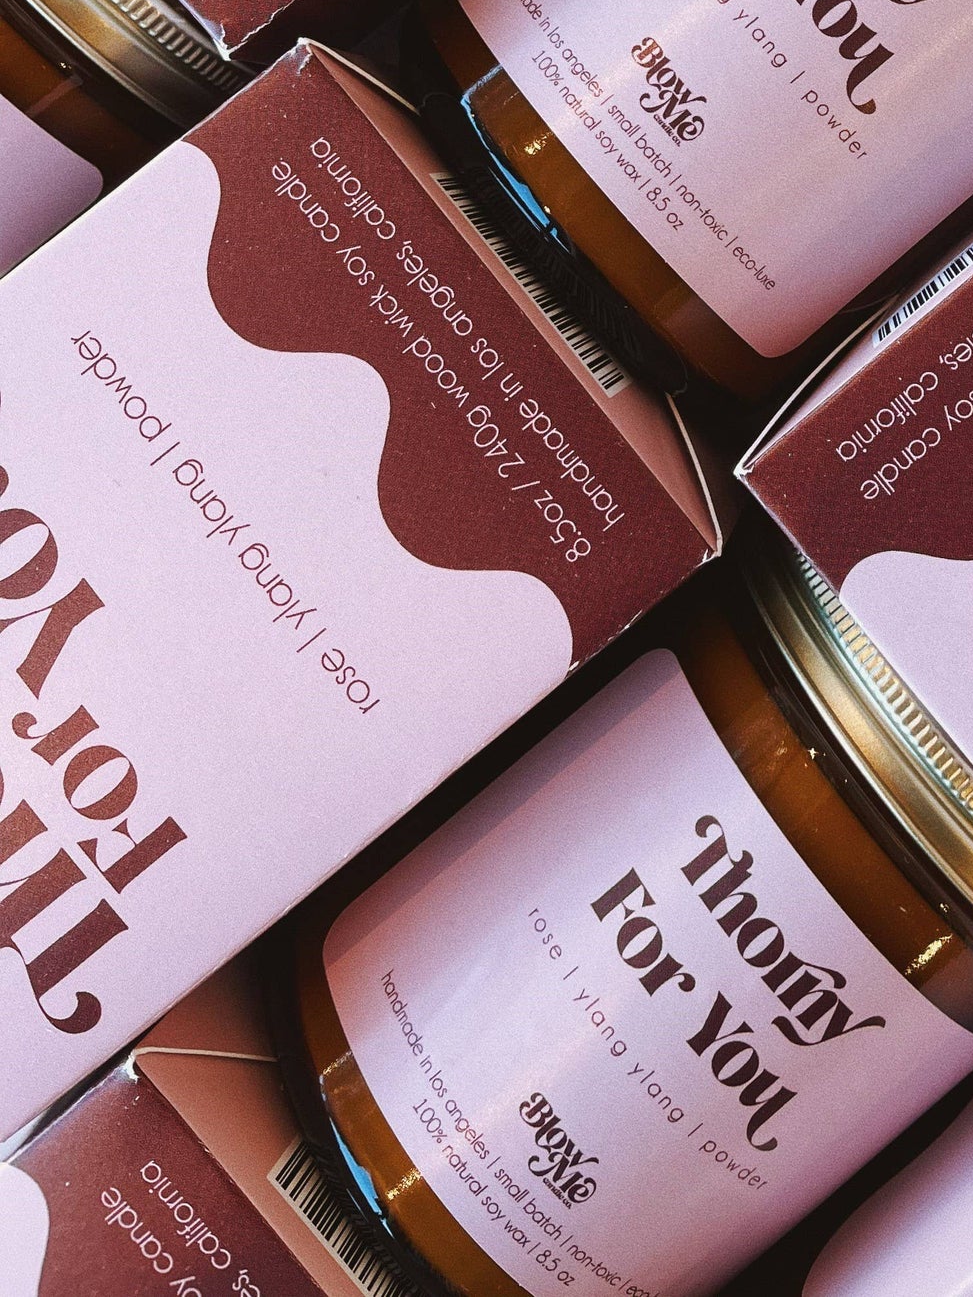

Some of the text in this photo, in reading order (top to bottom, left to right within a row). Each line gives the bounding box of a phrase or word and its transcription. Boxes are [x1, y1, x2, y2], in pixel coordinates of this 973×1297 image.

[531, 50, 684, 231] 100% natural soy wax 8.5 oz
[538, 16, 550, 32] in
[546, 26, 565, 49] los
[561, 48, 603, 98] angeles
[607, 104, 641, 138] small
[633, 132, 672, 178] batch
[631, 37, 707, 105] Blow
[732, 8, 788, 68] ylang
[800, 89, 867, 159] powder
[271, 161, 591, 563] 8.5oz 240g wood wick soy candle
[309, 136, 625, 532] handmade in los angeles, california
[835, 371, 939, 462] california
[70, 330, 380, 714] rose ylang ylang powder
[859, 427, 941, 500] candle
[12, 704, 187, 894] For
[590, 867, 797, 1152] For You
[681, 814, 886, 1046] Thorny
[381, 969, 563, 1241] handmade los angeles small batch
[519, 1092, 599, 1167] Blow
[528, 907, 767, 1189] rose ylang ylang powder
[100, 1186, 174, 1274] candle
[139, 1160, 231, 1270] california
[412, 1098, 575, 1286] 100% natural soy wax 8.5 oz
